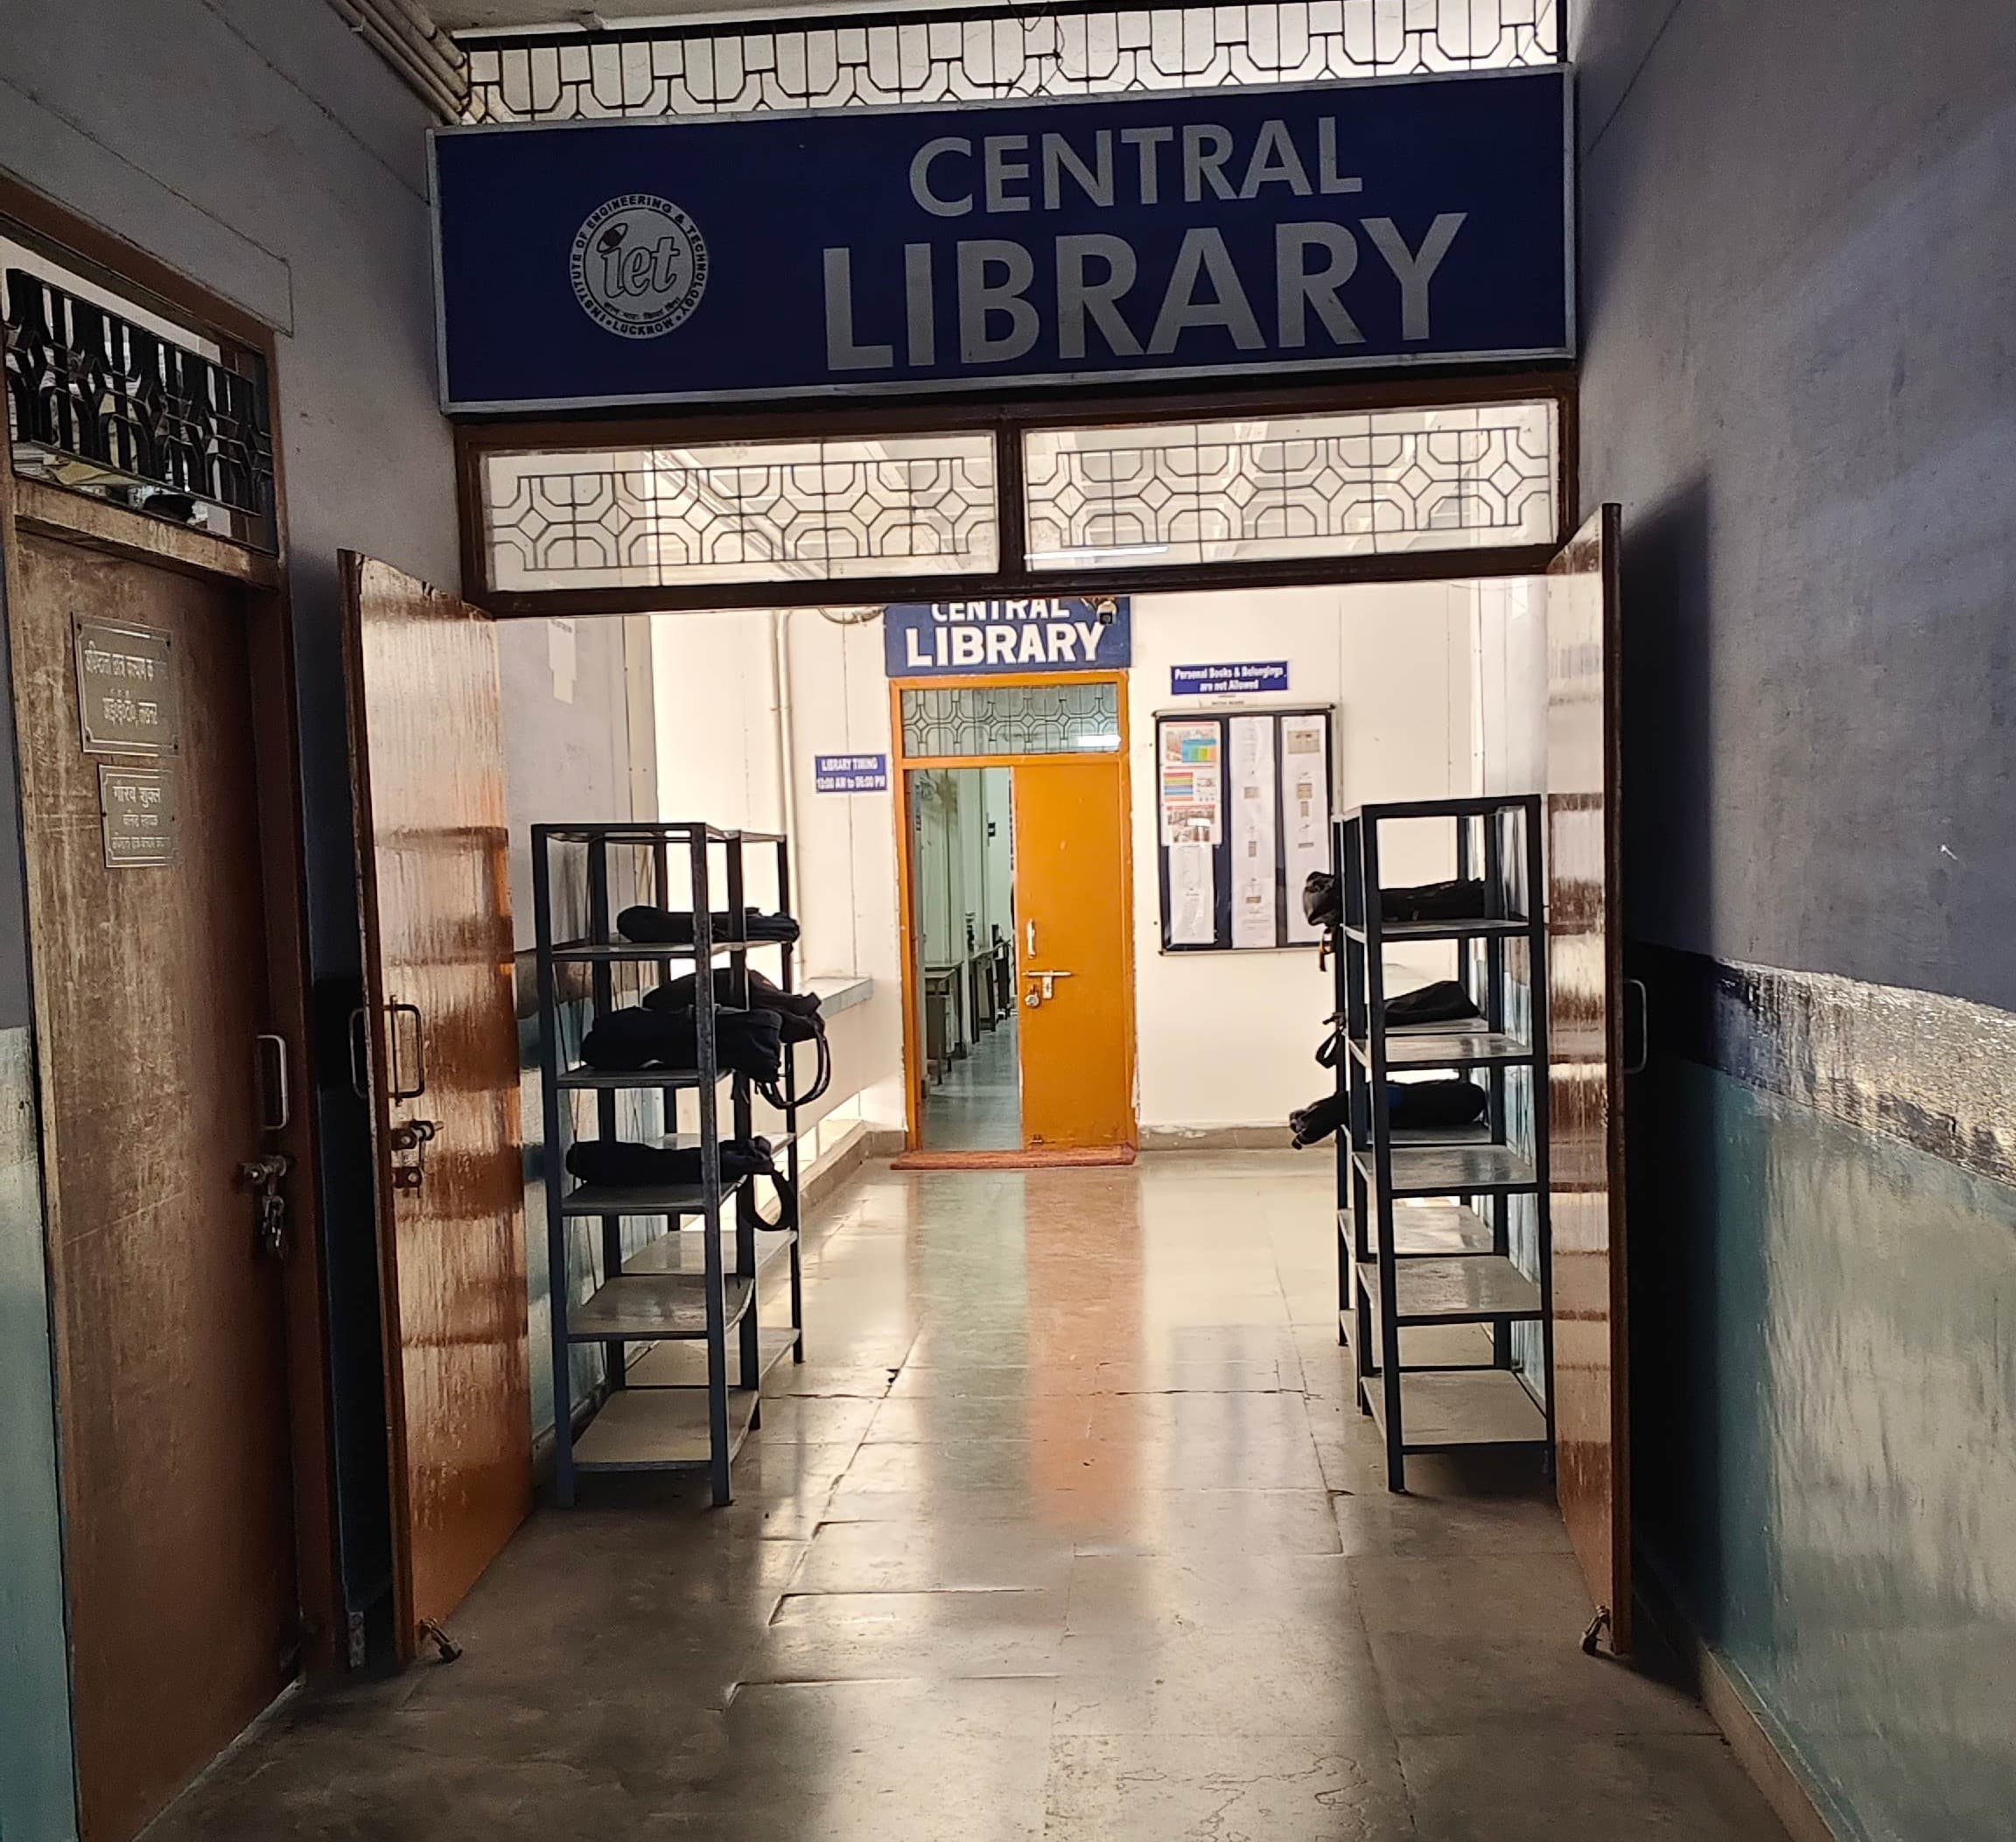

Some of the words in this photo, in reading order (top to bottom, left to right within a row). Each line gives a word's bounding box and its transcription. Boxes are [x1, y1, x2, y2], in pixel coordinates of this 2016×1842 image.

[909, 116, 1363, 217] CENTRAL
[586, 195, 673, 229] ENGINEERING
[675, 214, 685, 224] &
[576, 231, 589, 249] OF
[681, 225, 707, 316] TECHNOLOGY
[571, 254, 608, 322] INSTITUTE
[822, 212, 1468, 371] LIBRARY
[612, 318, 674, 335] LUCKNOW
[906, 622, 1106, 668] LIBRARY
[1174, 669, 1208, 680] Personal
[1209, 667, 1232, 678] Books
[1234, 667, 1240, 677] &
[1200, 683, 1213, 691] are
[1214, 681, 1227, 690] not
[821, 758, 851, 771] LIBRARY
